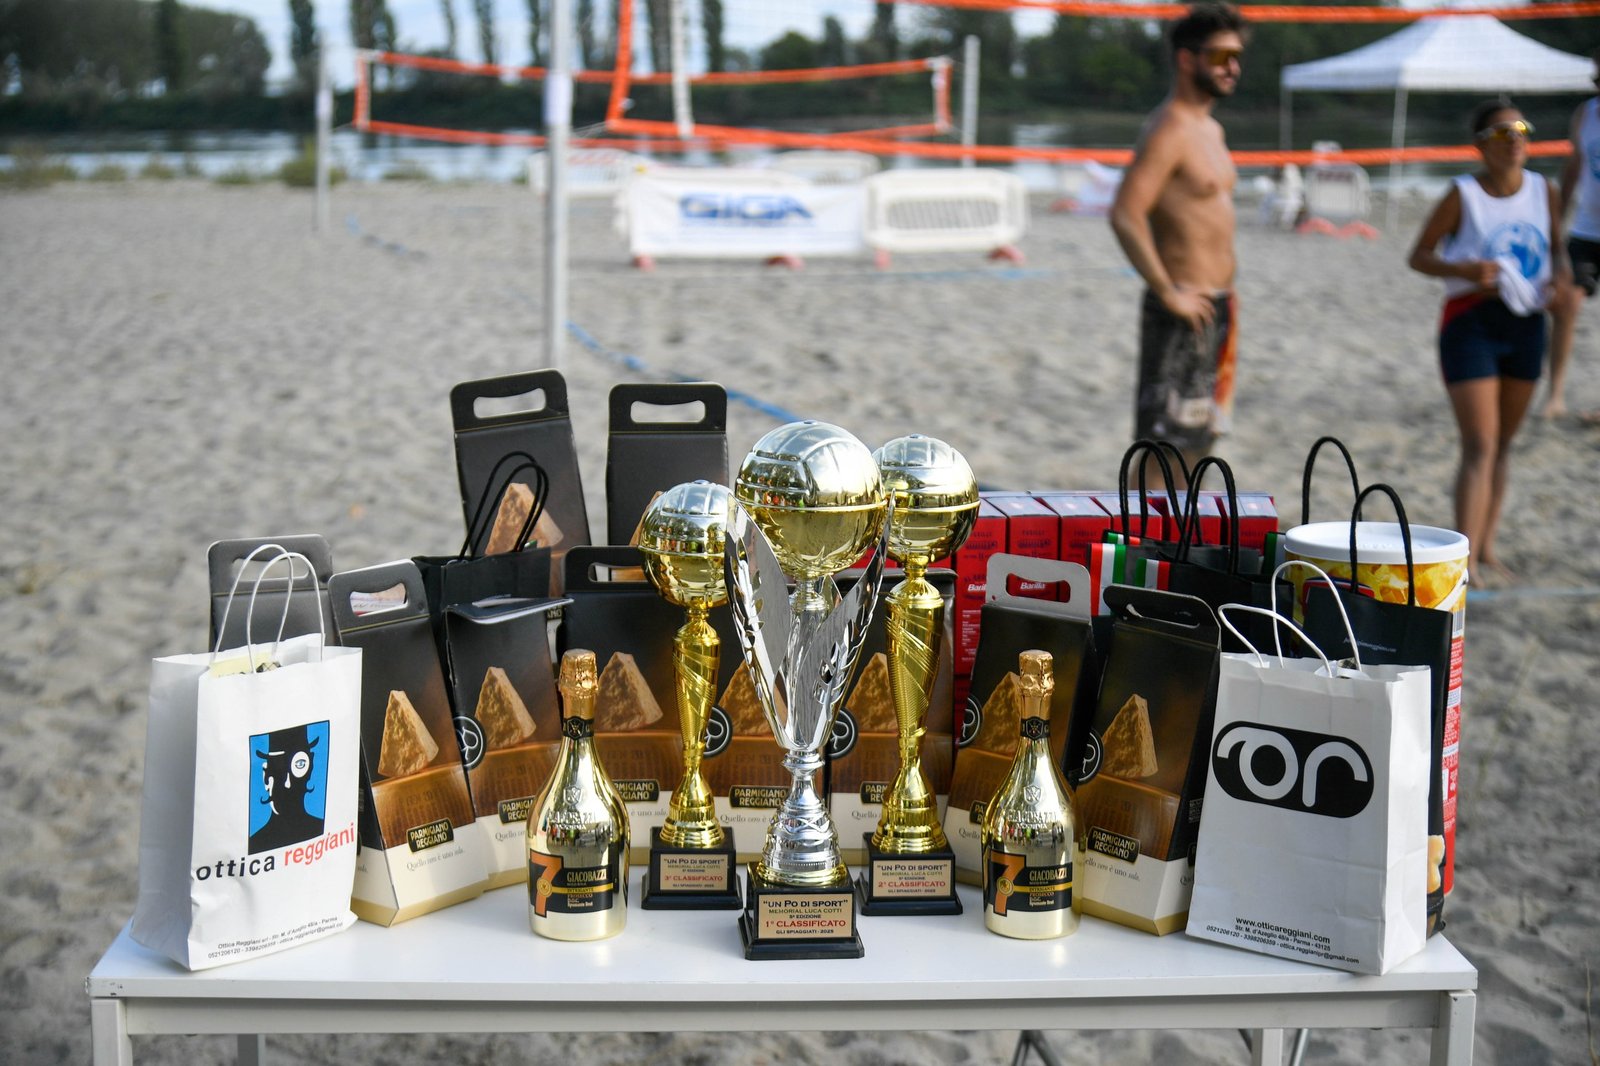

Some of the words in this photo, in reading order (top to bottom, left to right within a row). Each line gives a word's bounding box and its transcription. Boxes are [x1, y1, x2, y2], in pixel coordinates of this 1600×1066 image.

[1020, 582, 1046, 591] Barilla
[734, 788, 786, 798] PARMIGIANO
[739, 797, 781, 807] REGGIANO
[720, 814, 746, 823] Quello
[851, 810, 877, 820] Quello
[410, 821, 449, 839] PARMIGIANO
[495, 829, 516, 841] Quello
[416, 833, 447, 849] REGGIANO
[1092, 830, 1136, 851] PARMIGIANO
[196, 854, 276, 881] ottica
[283, 822, 355, 866] reggiani
[1094, 840, 1130, 859] REGGIANO
[406, 858, 427, 871] Quello
[567, 869, 607, 882] GIACOBAZZI
[1030, 868, 1067, 881] GIACOBAZZI
[530, 848, 564, 918] 7
[990, 850, 1026, 917] 7
[776, 920, 846, 928] CLASSIFICATO
[1236, 917, 1331, 943] www.otticareggiani.com
[218, 941, 236, 949] Ottica
[236, 938, 261, 948] Reggiani
[321, 916, 338, 924] Parma
[1293, 937, 1311, 946] Parma
